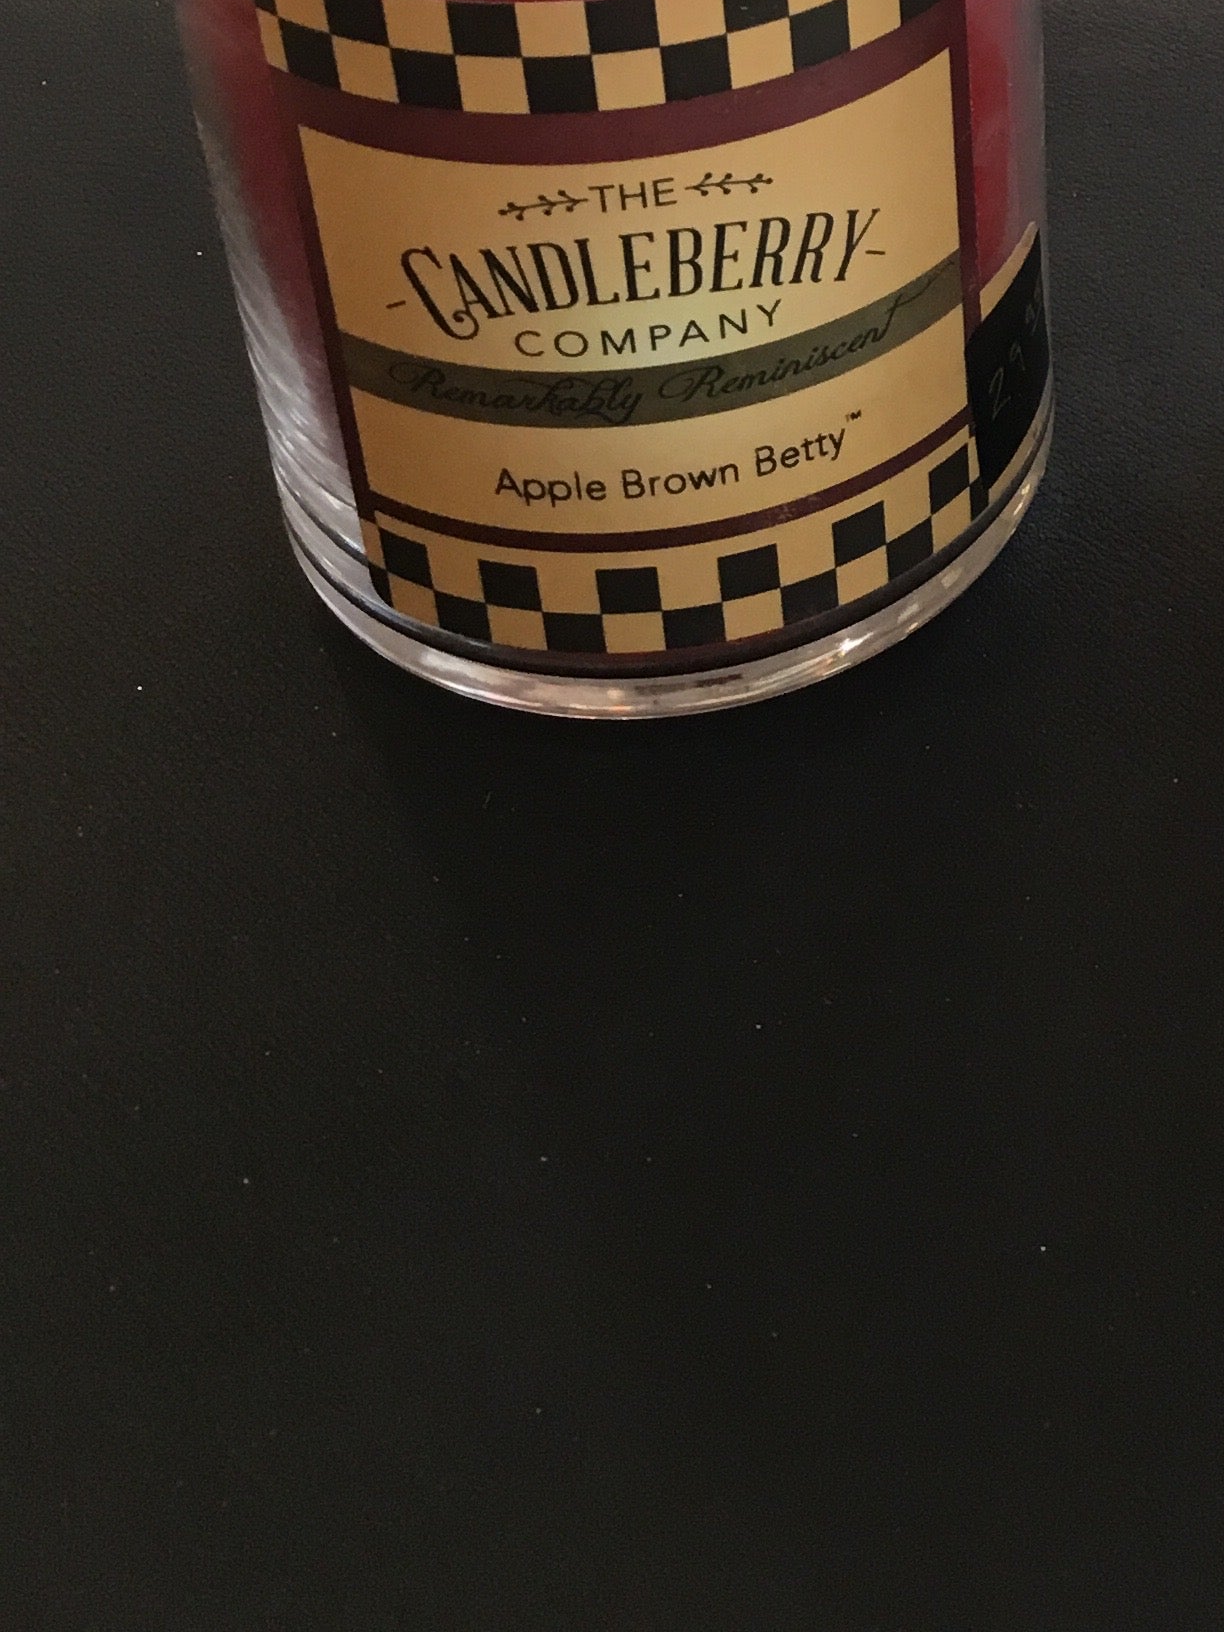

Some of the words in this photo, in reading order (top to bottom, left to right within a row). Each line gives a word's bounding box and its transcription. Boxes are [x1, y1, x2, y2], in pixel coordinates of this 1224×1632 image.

[588, 178, 679, 213] THE
[400, 208, 880, 341] CANDLEBERRY
[388, 362, 643, 422] Remarkably
[658, 260, 957, 403] Reminiscent
[514, 299, 783, 358] COMPANY
[494, 466, 607, 507] Apple
[622, 460, 740, 500] Brown
